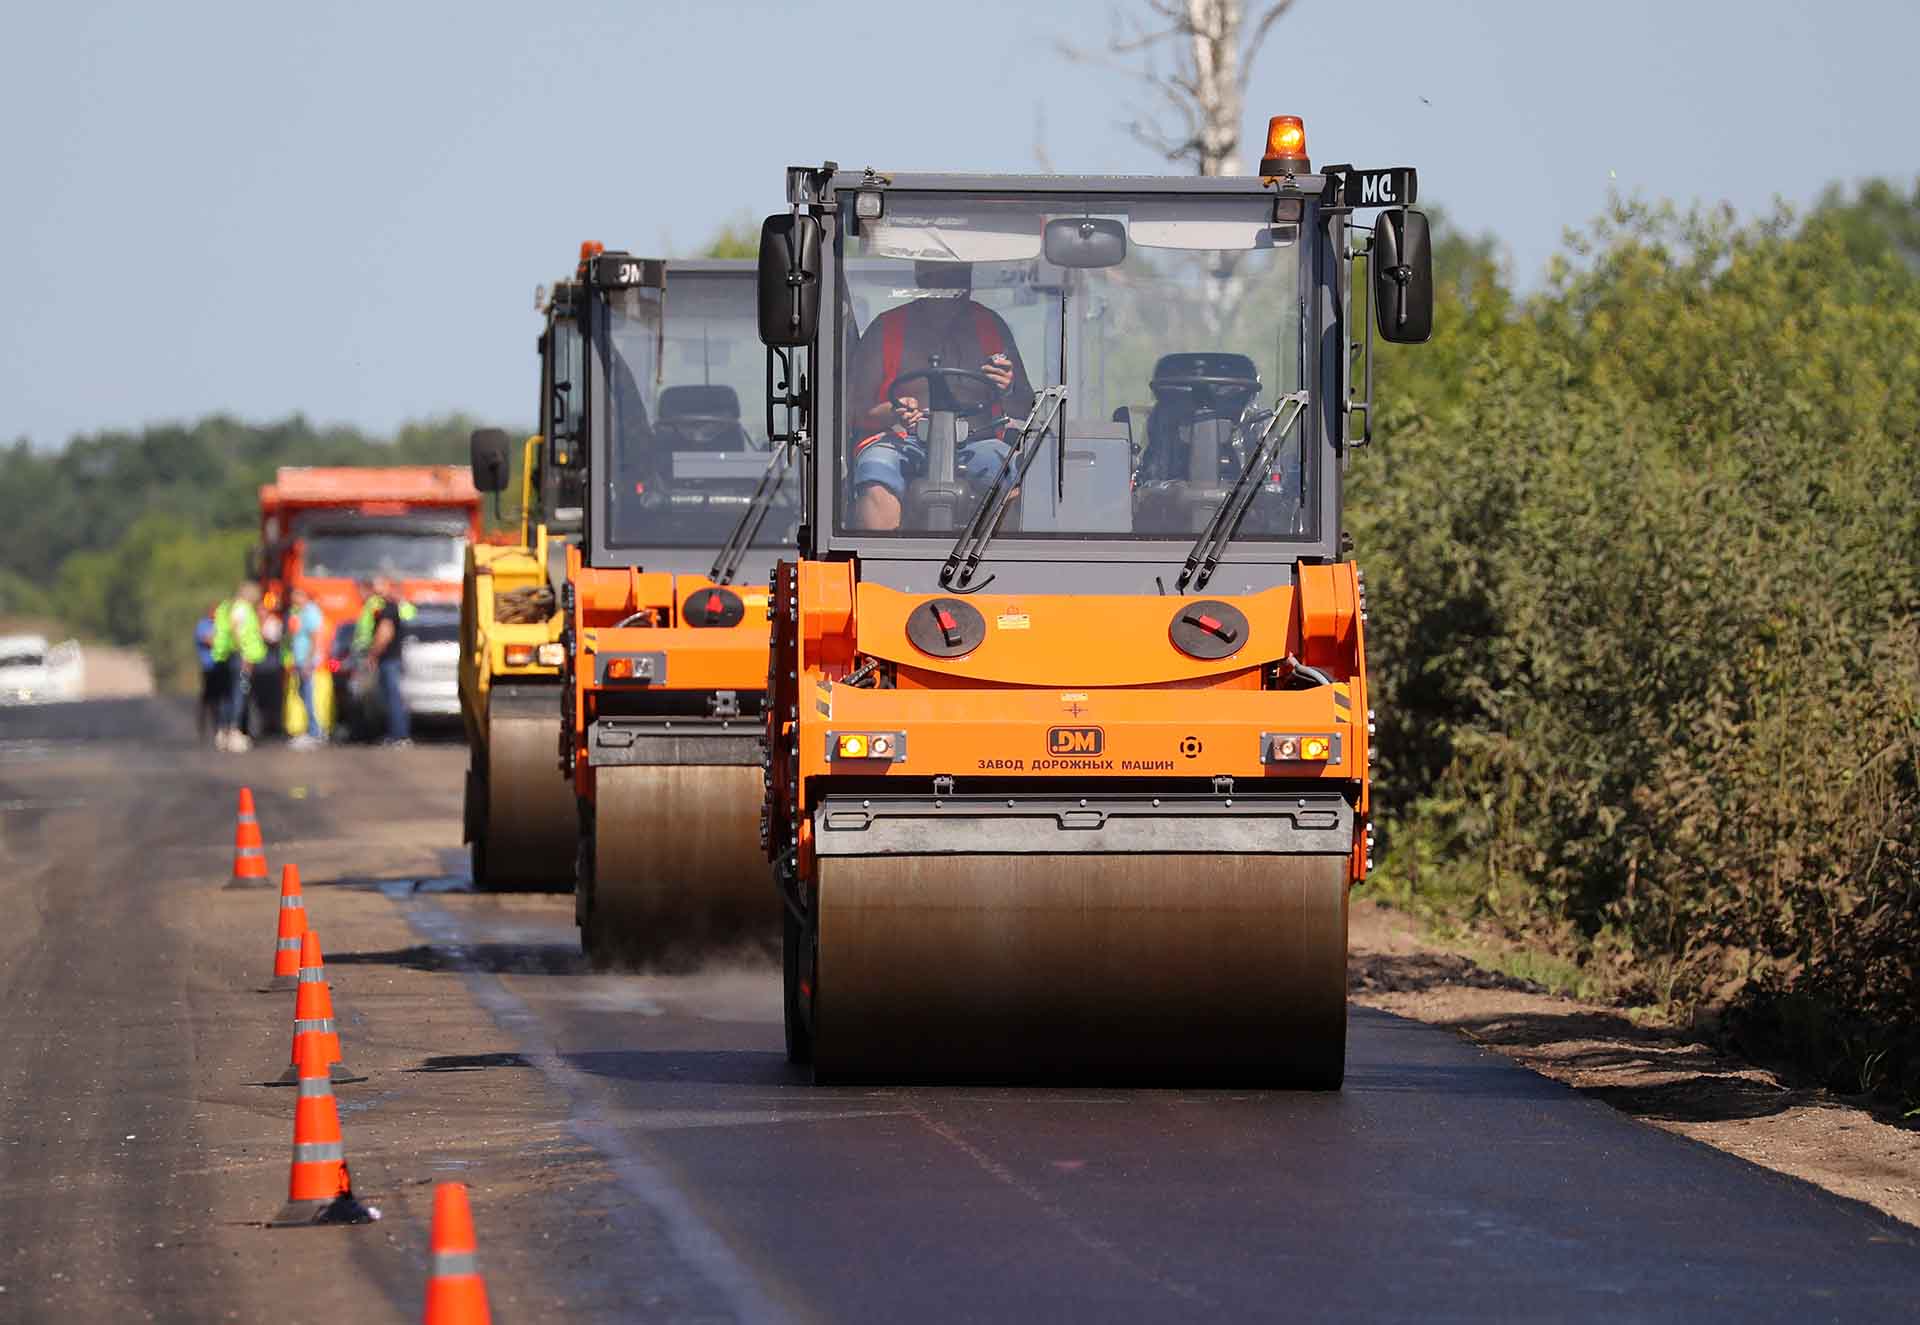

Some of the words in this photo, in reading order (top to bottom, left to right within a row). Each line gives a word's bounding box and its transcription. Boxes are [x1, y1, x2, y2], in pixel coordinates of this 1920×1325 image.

[977, 759, 1024, 770] ЗАВОД
[1031, 759, 1114, 770] ДОРОЖНЫХ
[1121, 760, 1175, 771] МАШИН
